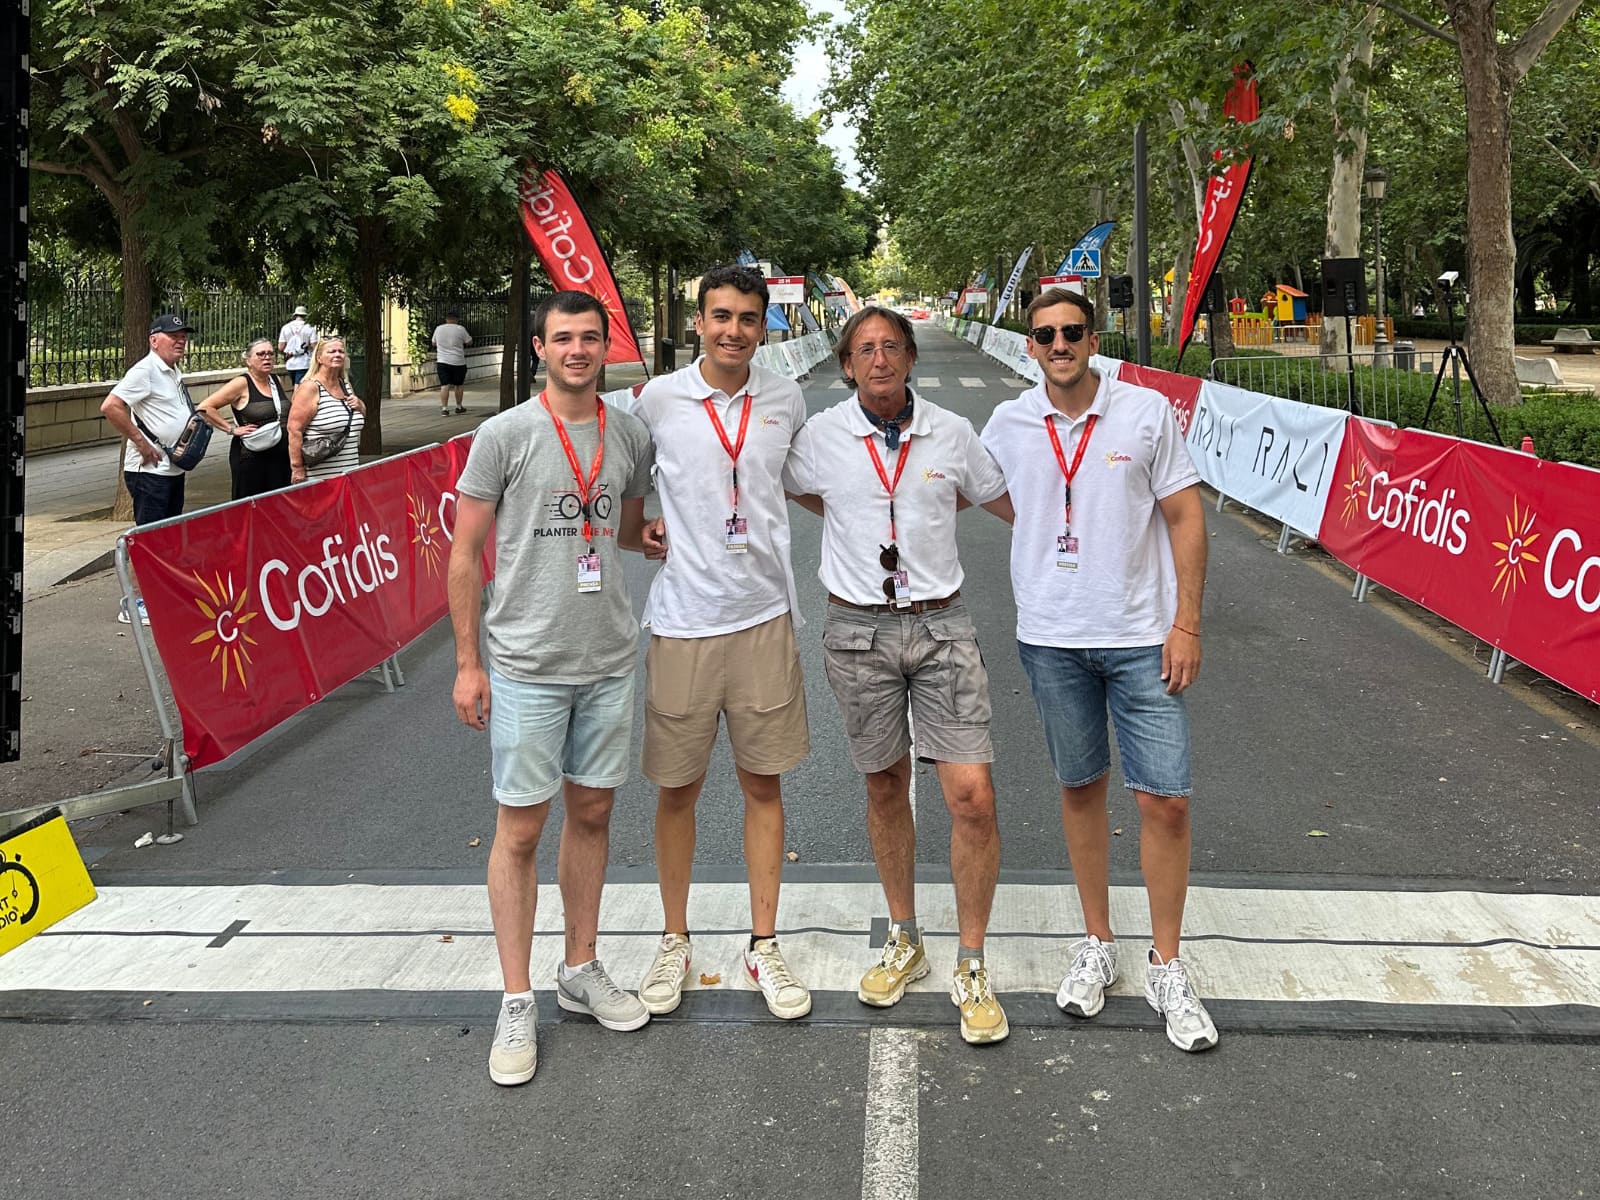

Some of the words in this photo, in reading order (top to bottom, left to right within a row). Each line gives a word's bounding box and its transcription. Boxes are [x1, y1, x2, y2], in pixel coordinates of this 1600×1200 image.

[1252, 426, 1328, 497] RALI
[533, 527, 578, 538] PLANTER
[1367, 470, 1471, 555] Cofidis
[258, 522, 399, 631] Cofidis
